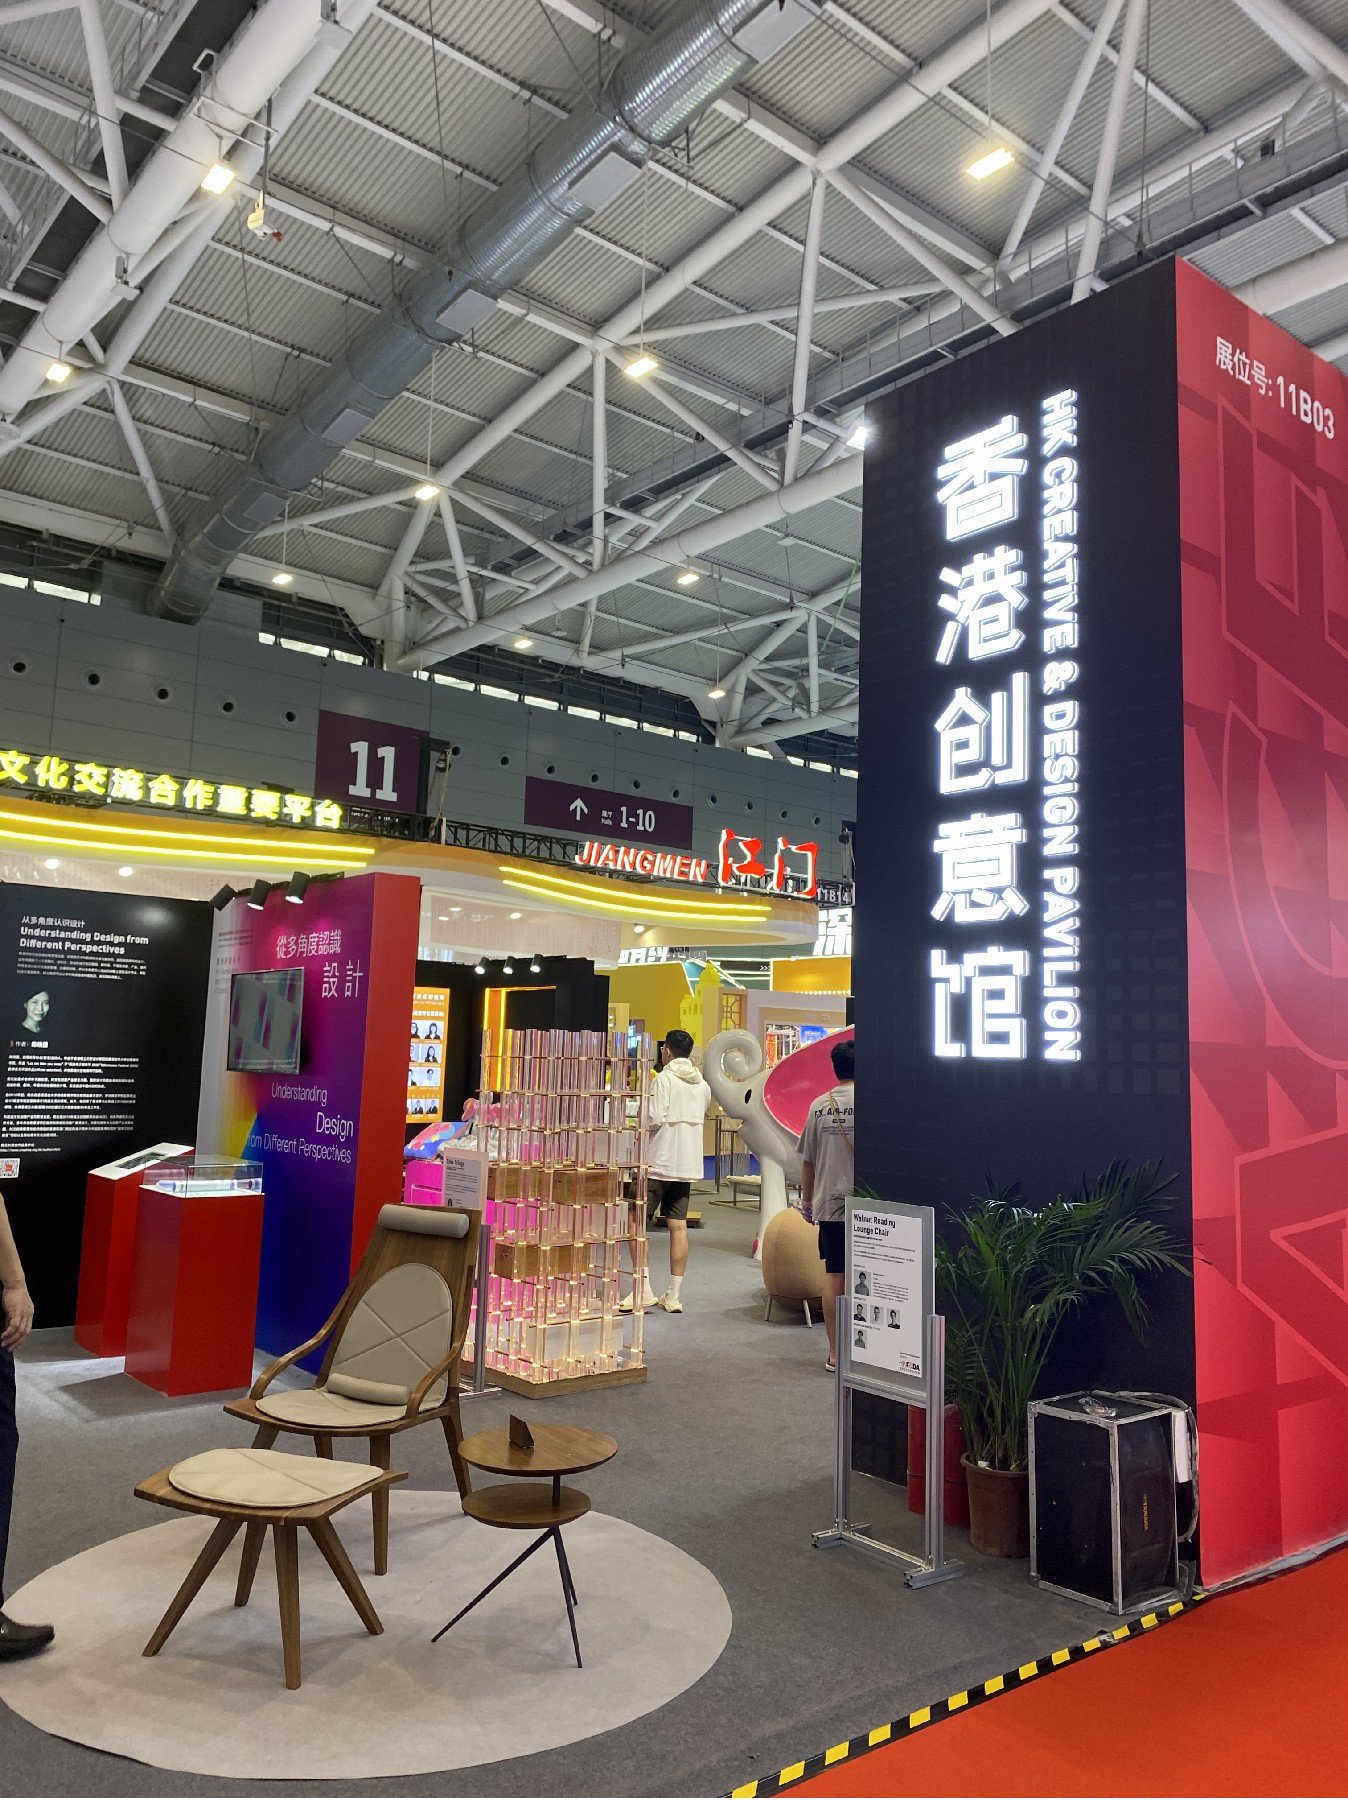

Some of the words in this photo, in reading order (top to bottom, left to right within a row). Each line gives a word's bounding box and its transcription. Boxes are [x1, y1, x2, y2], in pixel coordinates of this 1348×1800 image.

[1042, 388, 1078, 457] HK
[1043, 457, 1079, 653] CREATIVE
[1043, 660, 1079, 695] &
[931, 414, 1029, 1059] 香港创意馆
[0, 750, 344, 830] 文化交流合作重要平台
[348, 740, 398, 802] 11
[1043, 700, 1080, 856] DESIGN
[620, 806, 656, 832] 1-10
[575, 840, 708, 882] JIANGMEN
[718, 828, 819, 899] 江门
[19, 938, 63, 950] Different
[64, 941, 126, 955] Perspectives
[20, 926, 91, 942] Understanding
[93, 932, 125, 944] Design
[126, 934, 149, 945] from
[276, 929, 342, 959] 從多角度認識
[321, 958, 364, 998] 設計
[1043, 866, 1081, 1061] PAVILION
[271, 1080, 328, 1107] Understanding
[316, 1111, 354, 1142] Design
[263, 1133, 297, 1155] Different
[298, 1138, 352, 1164] Perspectives
[853, 1224, 874, 1236] Lounge
[874, 1227, 890, 1237] Chair
